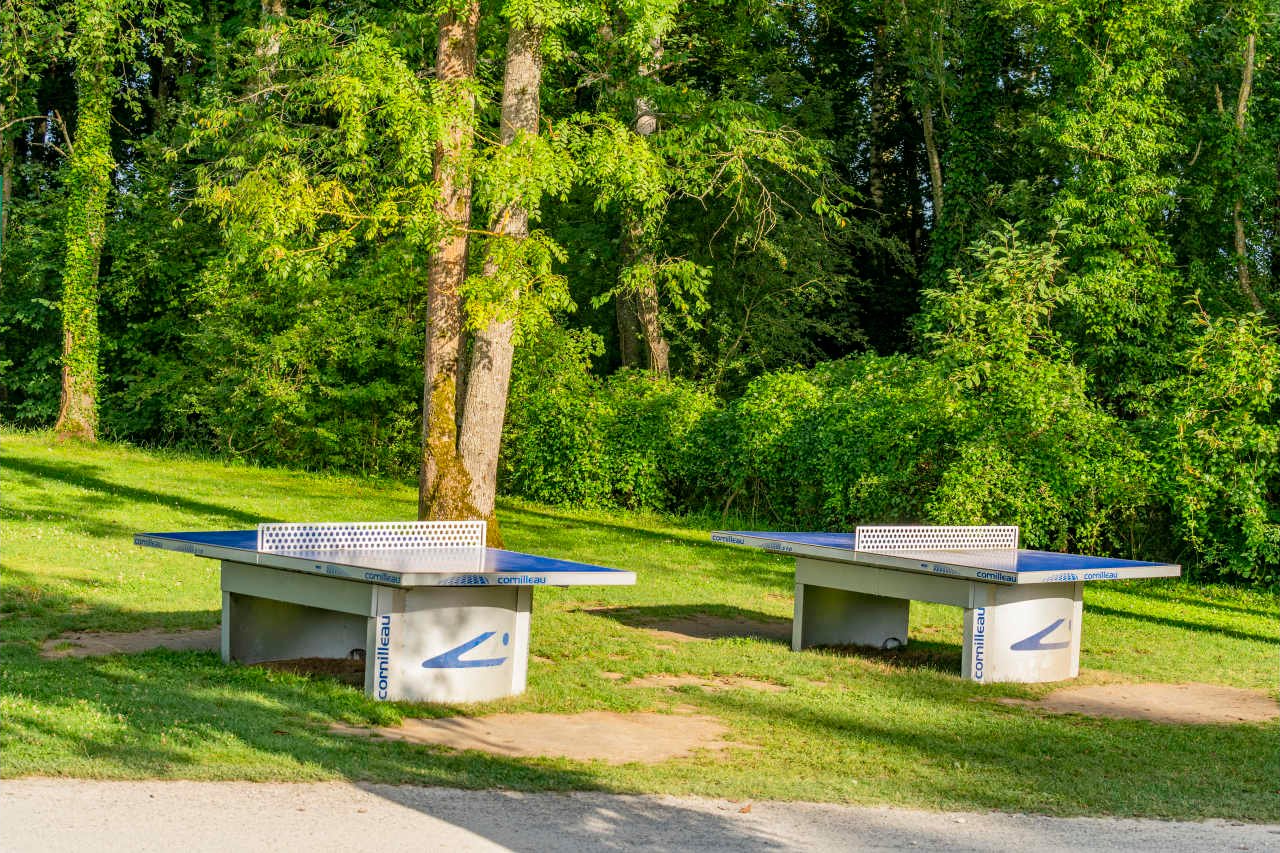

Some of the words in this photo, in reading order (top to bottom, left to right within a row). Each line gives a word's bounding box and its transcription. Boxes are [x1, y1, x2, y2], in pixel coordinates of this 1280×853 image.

[712, 535, 745, 545] cornilleau
[365, 572, 401, 584] cornilleau
[497, 575, 546, 585] cornilleau
[976, 570, 1017, 583] cornilleau
[1084, 571, 1118, 580] cornilleau
[974, 607, 986, 679] cornilleau
[377, 615, 391, 700] cornilleau
